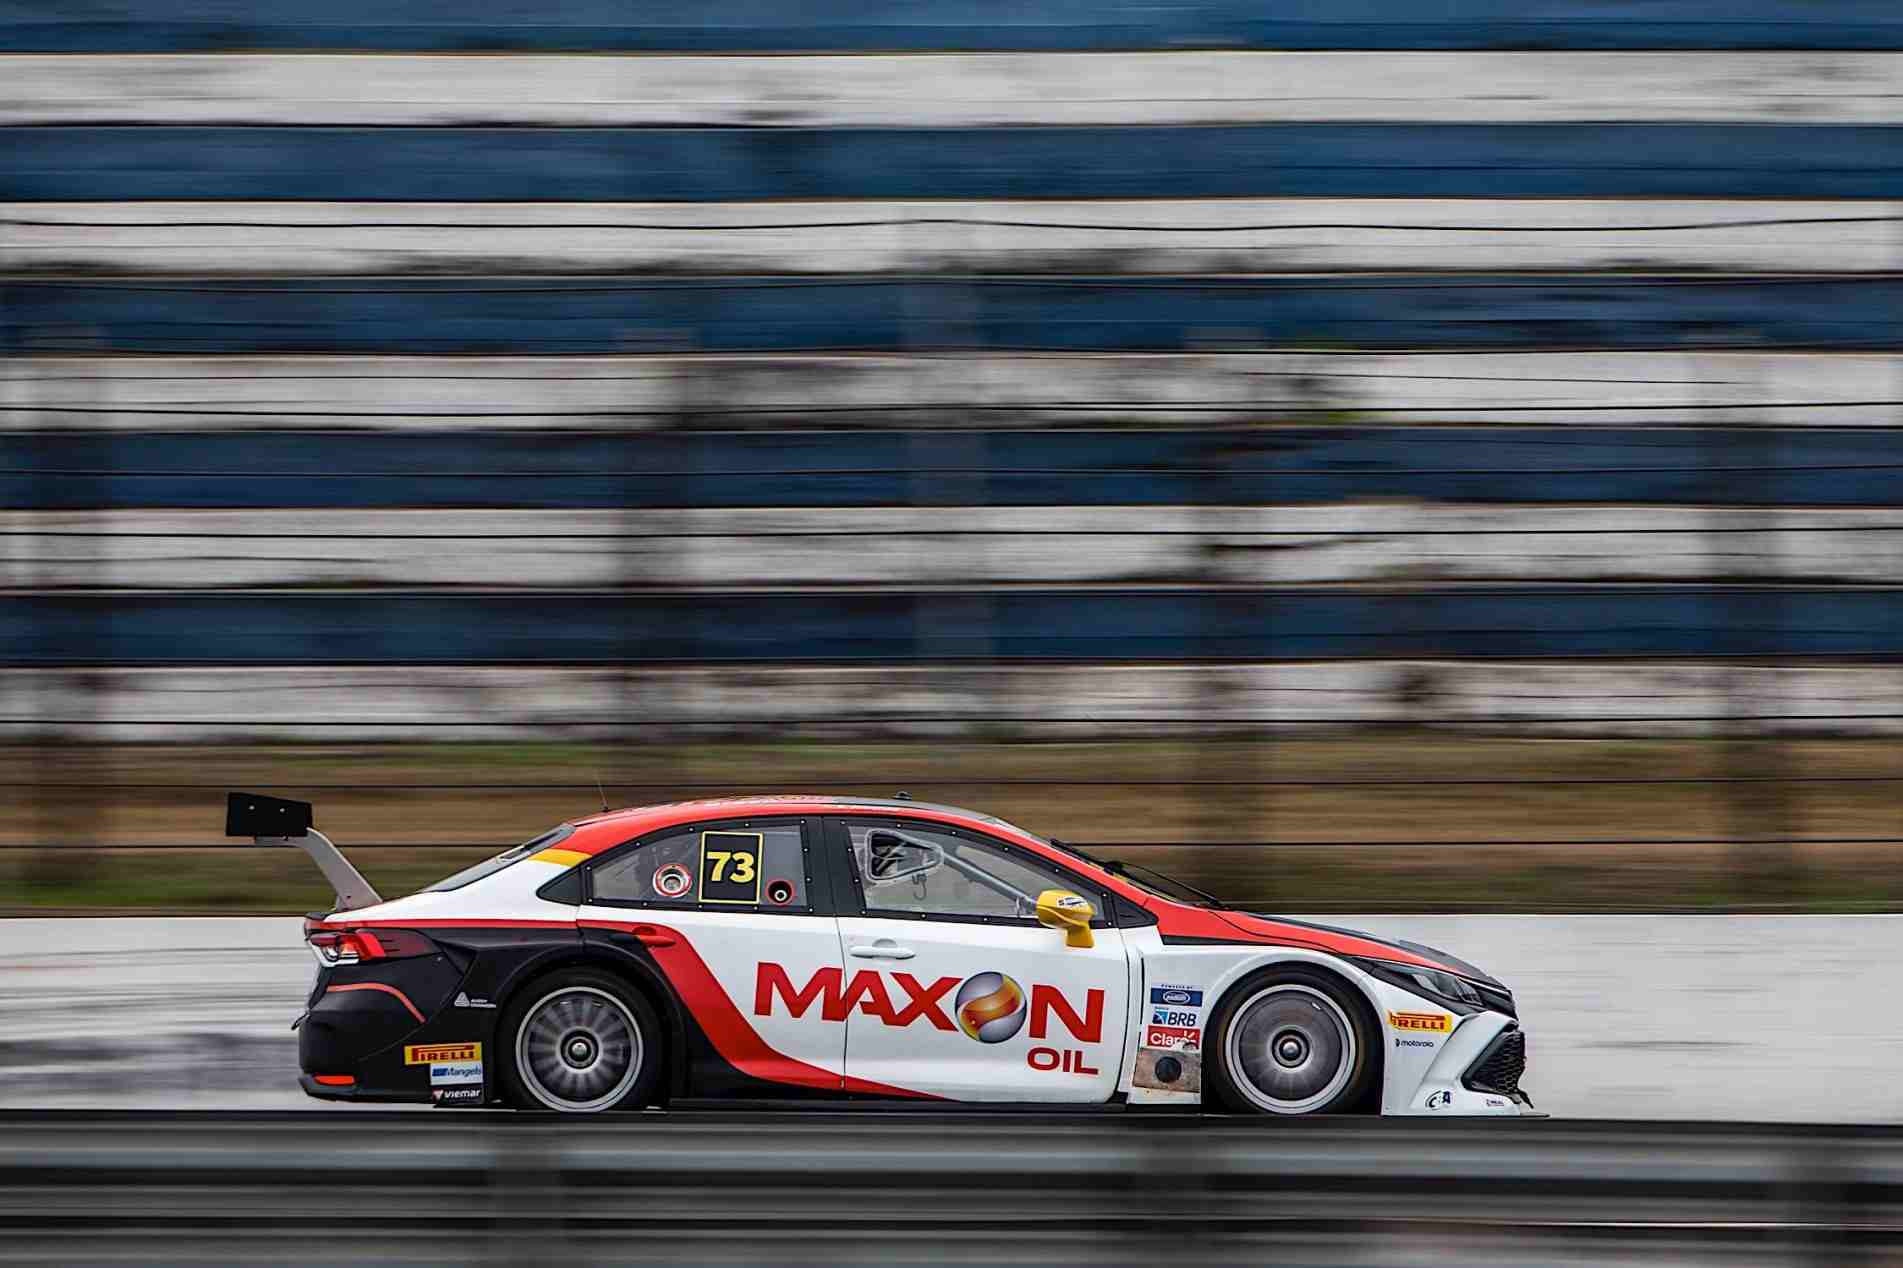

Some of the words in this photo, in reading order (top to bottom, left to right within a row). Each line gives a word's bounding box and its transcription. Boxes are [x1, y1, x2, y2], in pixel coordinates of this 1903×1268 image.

[706, 851, 755, 883] 73
[1168, 1012, 1197, 1027] BRB
[412, 1045, 474, 1061] PIRELLI
[1027, 1047, 1099, 1075] OIL
